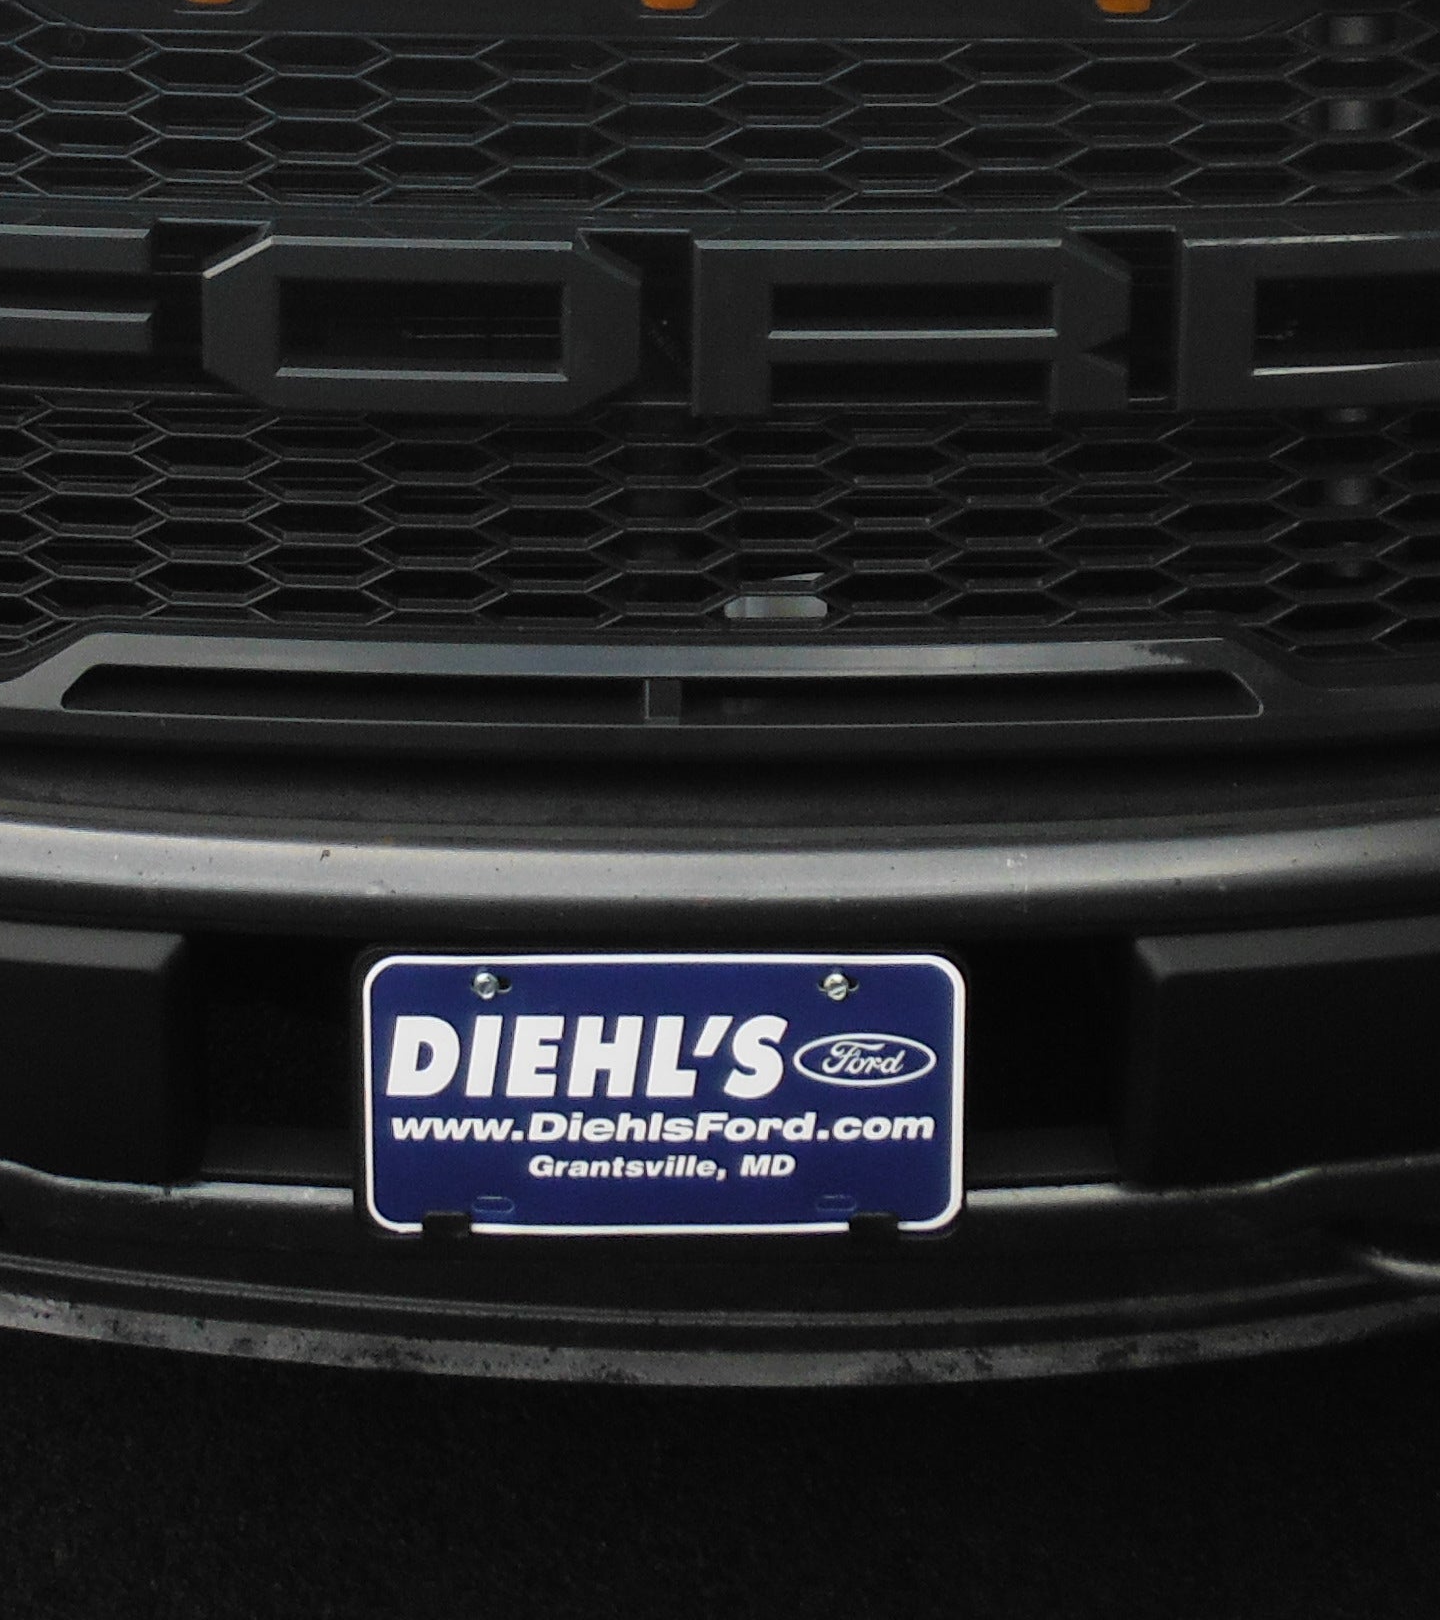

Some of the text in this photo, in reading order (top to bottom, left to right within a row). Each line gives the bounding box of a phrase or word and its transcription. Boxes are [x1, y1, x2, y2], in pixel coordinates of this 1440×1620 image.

[385, 1014, 789, 1099] DIEHL'S
[821, 1040, 906, 1075] Ford
[390, 1110, 935, 1143] www.DiehlsFord.com
[527, 1153, 797, 1181] Grantsville, MD
